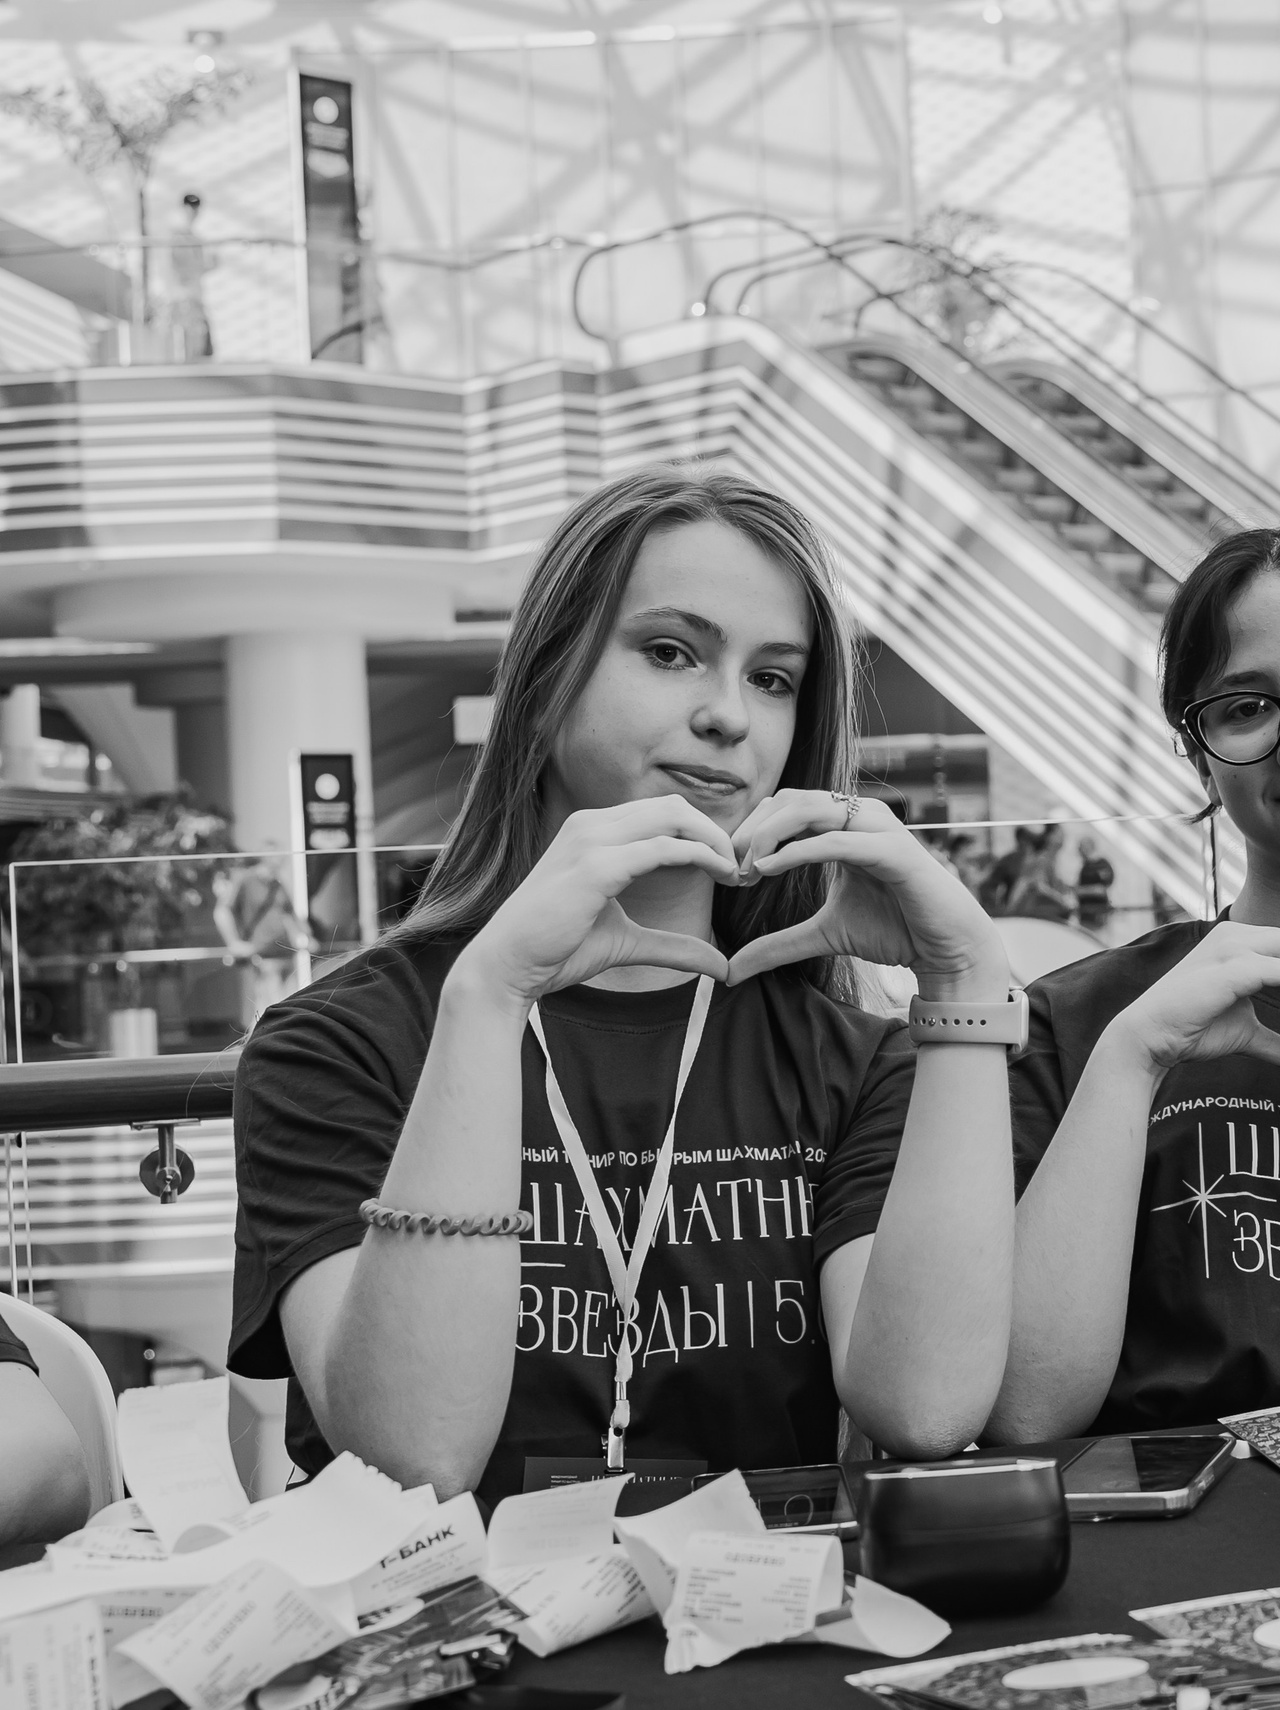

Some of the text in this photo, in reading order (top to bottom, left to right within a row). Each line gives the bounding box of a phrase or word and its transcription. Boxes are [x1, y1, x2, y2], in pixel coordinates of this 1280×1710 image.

[1148, 1096, 1275, 1128] ЖДУНАРОДНЫЙ
[521, 1146, 559, 1163] НЫЙ
[562, 1150, 616, 1169] ТНИР
[619, 1150, 638, 1167] ПО
[716, 1140, 801, 1163] ШАХМАТА
[515, 1283, 728, 1368] ЗВЕЗДЫ
